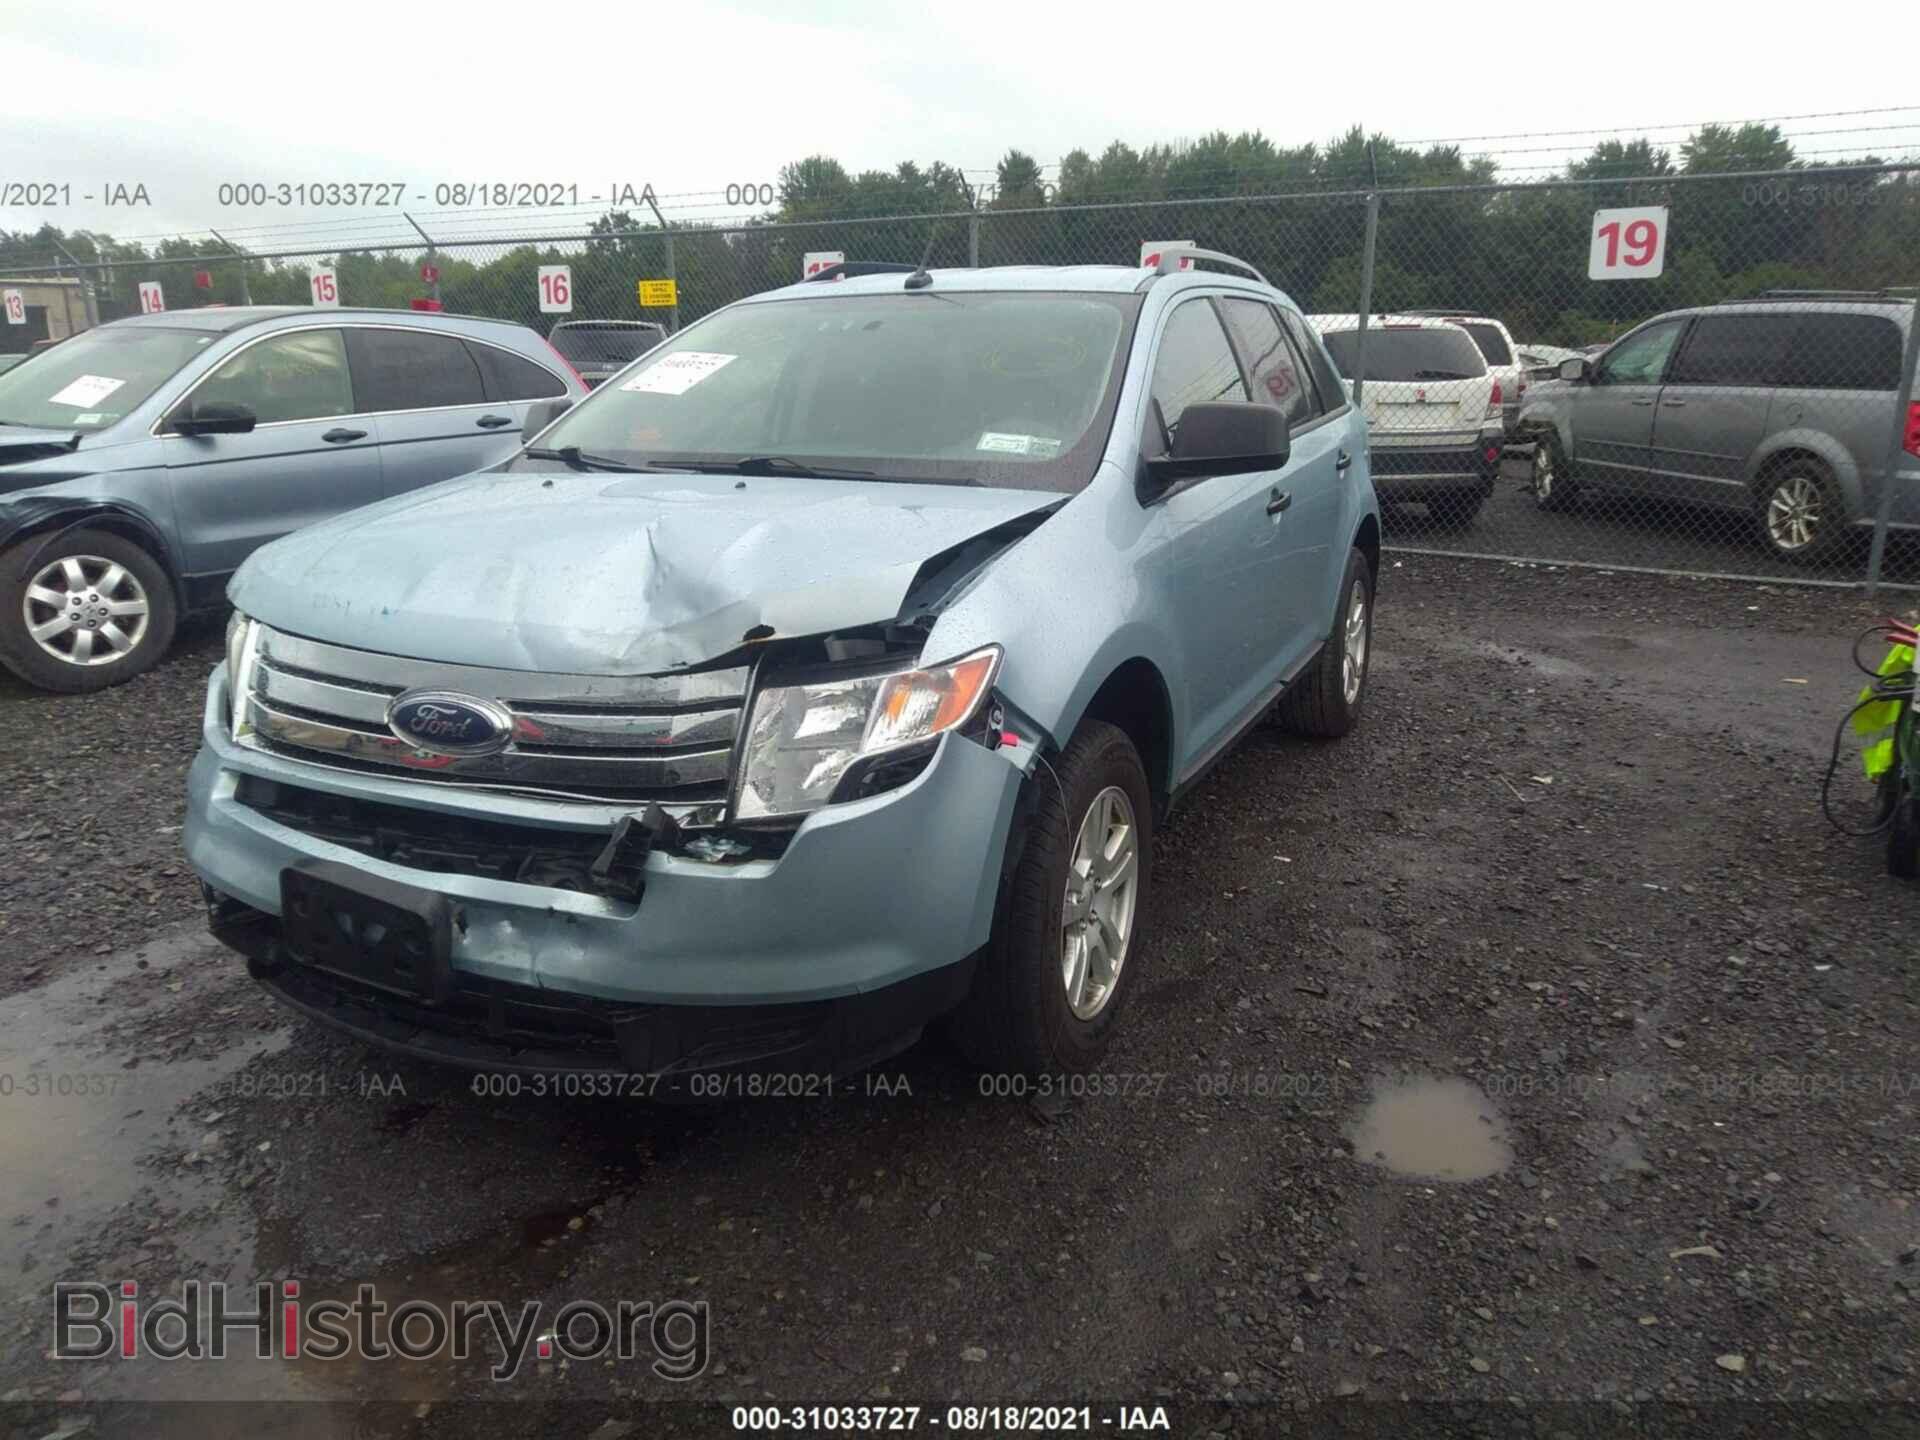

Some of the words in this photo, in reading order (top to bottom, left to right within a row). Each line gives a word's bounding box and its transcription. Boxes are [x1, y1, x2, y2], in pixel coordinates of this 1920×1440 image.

[1597, 219, 1659, 268] 19
[142, 288, 162, 312] 14
[312, 274, 336, 302] 15
[540, 273, 570, 305] 16
[7, 295, 23, 319] 13
[410, 704, 472, 736] Ford
